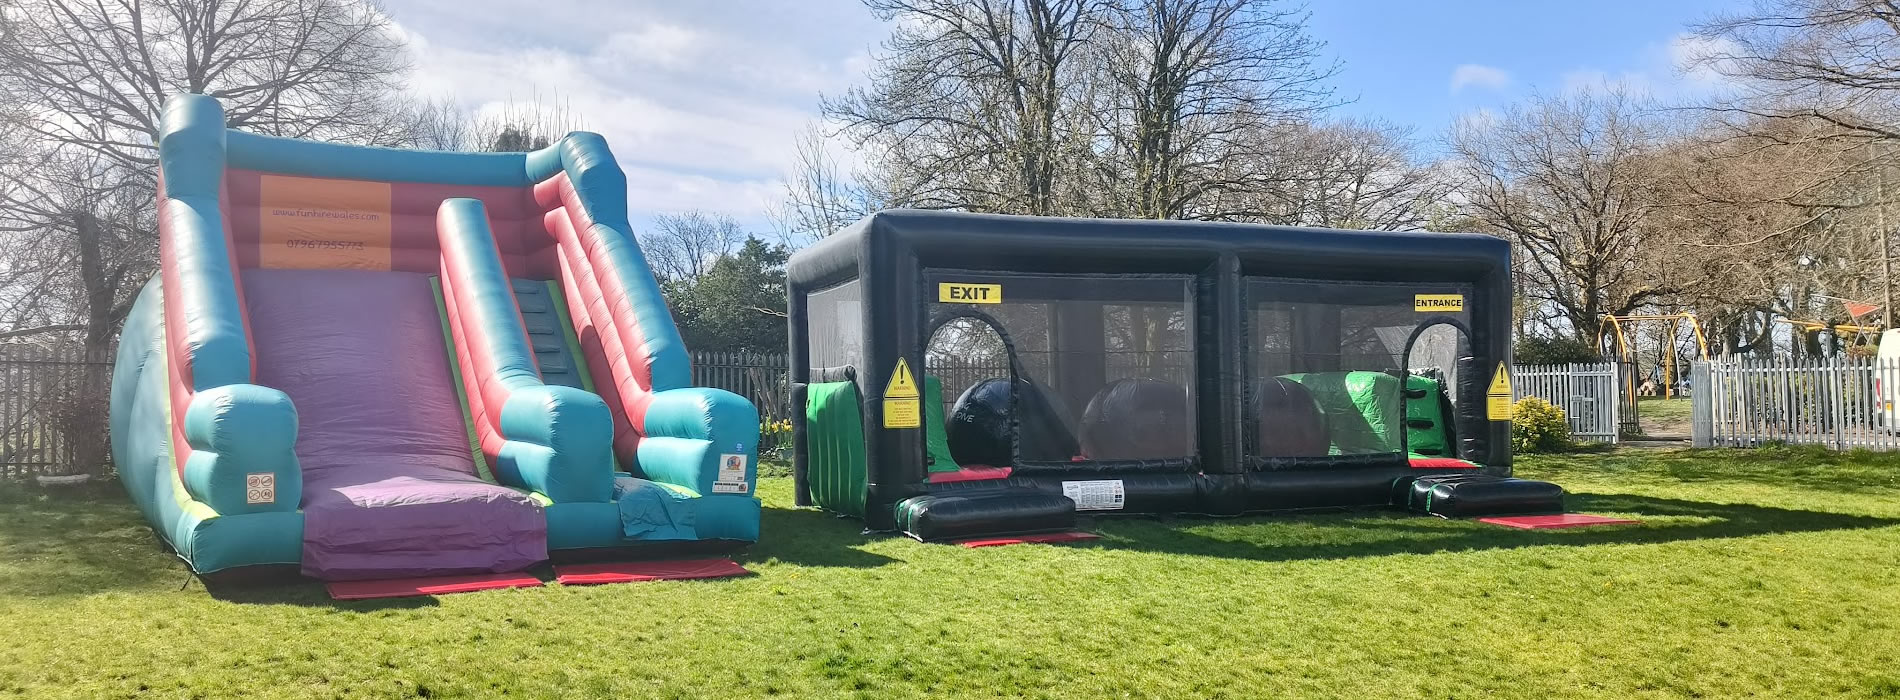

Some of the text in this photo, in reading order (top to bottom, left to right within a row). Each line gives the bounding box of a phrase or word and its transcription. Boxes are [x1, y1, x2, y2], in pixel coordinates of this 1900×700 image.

[272, 208, 380, 221] www.funhirewales.com
[950, 286, 990, 300] EXIT
[1415, 299, 1462, 307] ENTRANCE
